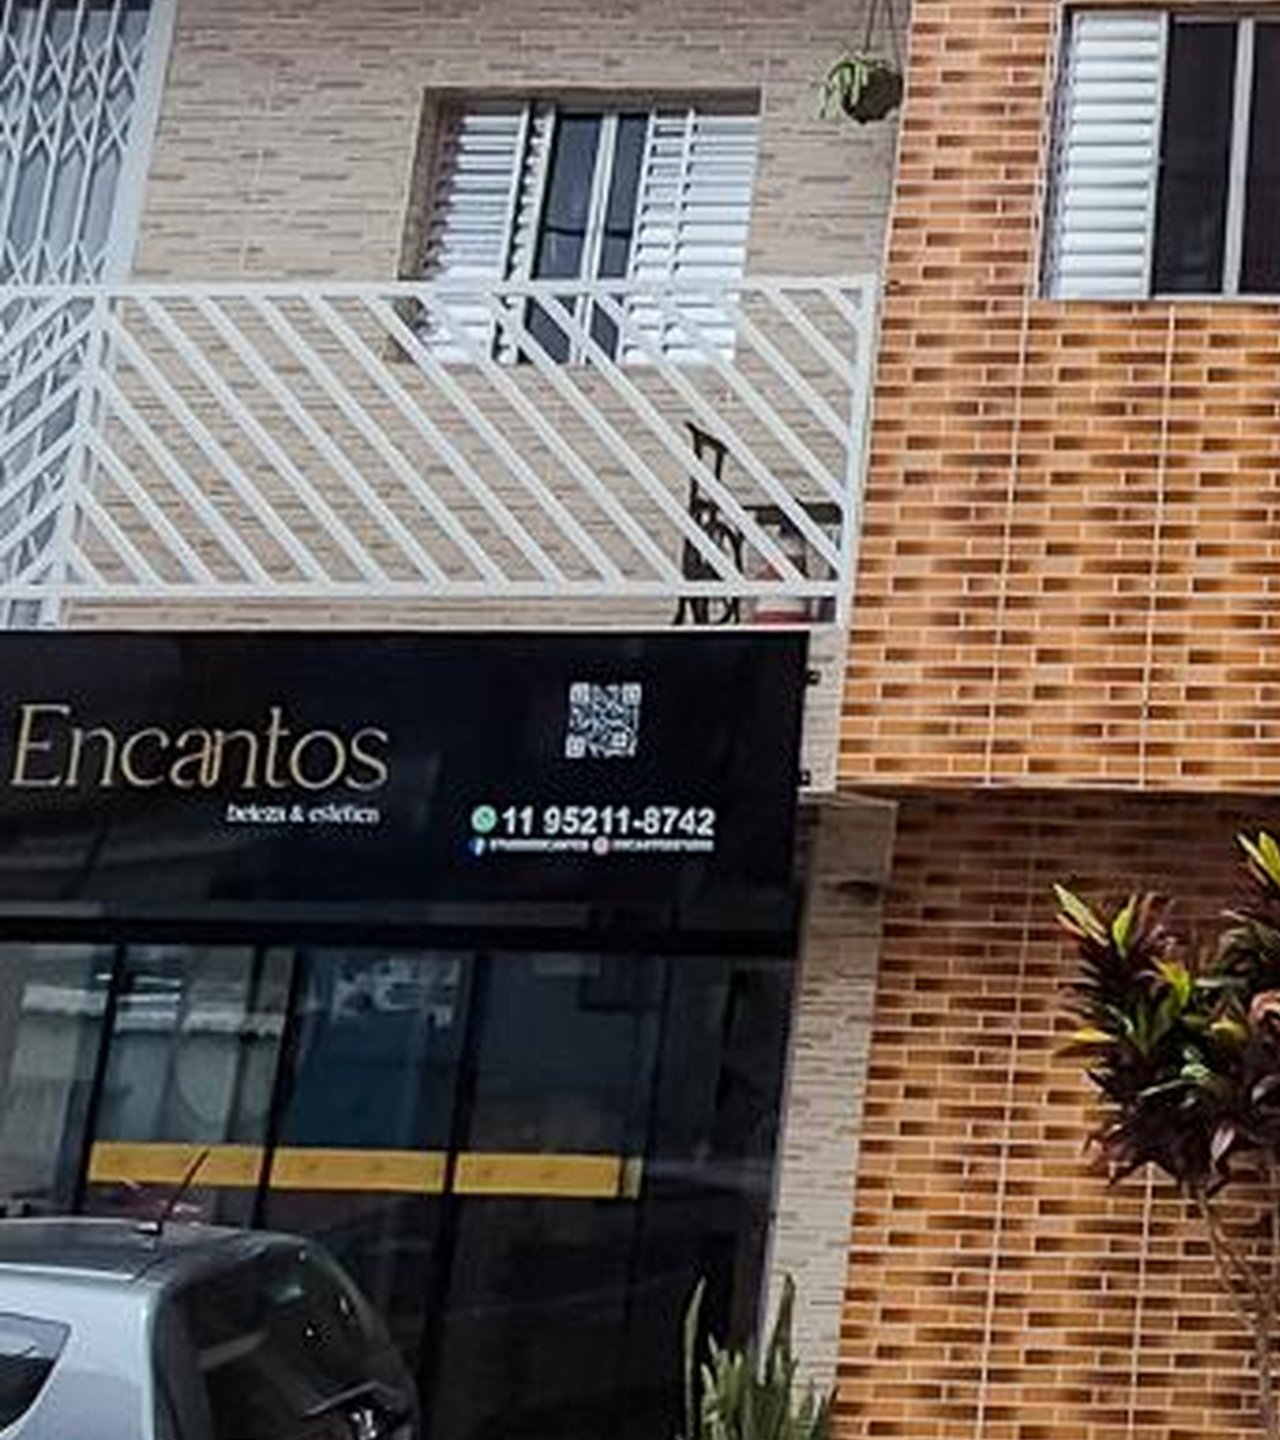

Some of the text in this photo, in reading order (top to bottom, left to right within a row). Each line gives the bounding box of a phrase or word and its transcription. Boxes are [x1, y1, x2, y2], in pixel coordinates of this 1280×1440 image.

[10, 703, 390, 791] Encantos
[502, 805, 716, 836] 11 95211-8742
